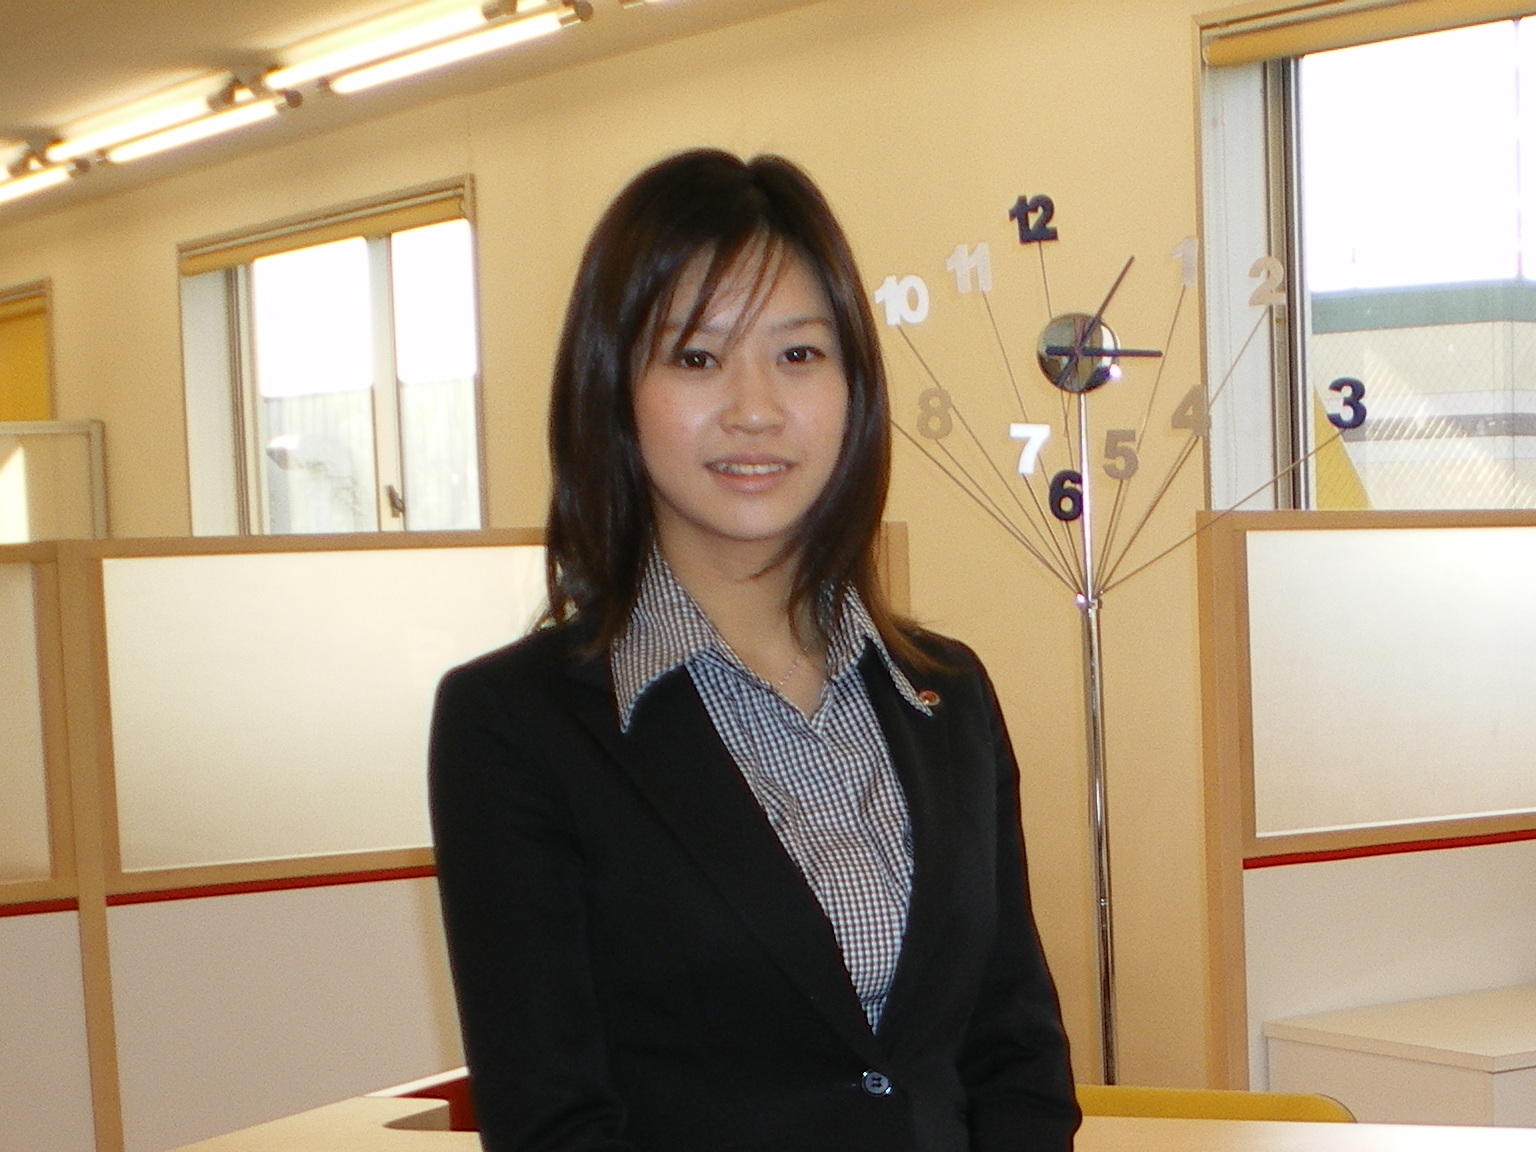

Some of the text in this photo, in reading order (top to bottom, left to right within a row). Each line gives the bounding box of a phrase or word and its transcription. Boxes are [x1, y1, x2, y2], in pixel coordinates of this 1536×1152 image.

[1009, 194, 1058, 244] 12
[945, 242, 992, 293] 11
[1171, 236, 1199, 286] 1
[1249, 256, 1286, 306] 2
[874, 275, 930, 326] 10
[917, 388, 953, 440] 8
[1171, 385, 1210, 437] 4
[1327, 378, 1367, 430] 3
[1009, 423, 1051, 474] 7
[1103, 429, 1139, 480] 5
[1049, 469, 1083, 522] 6
